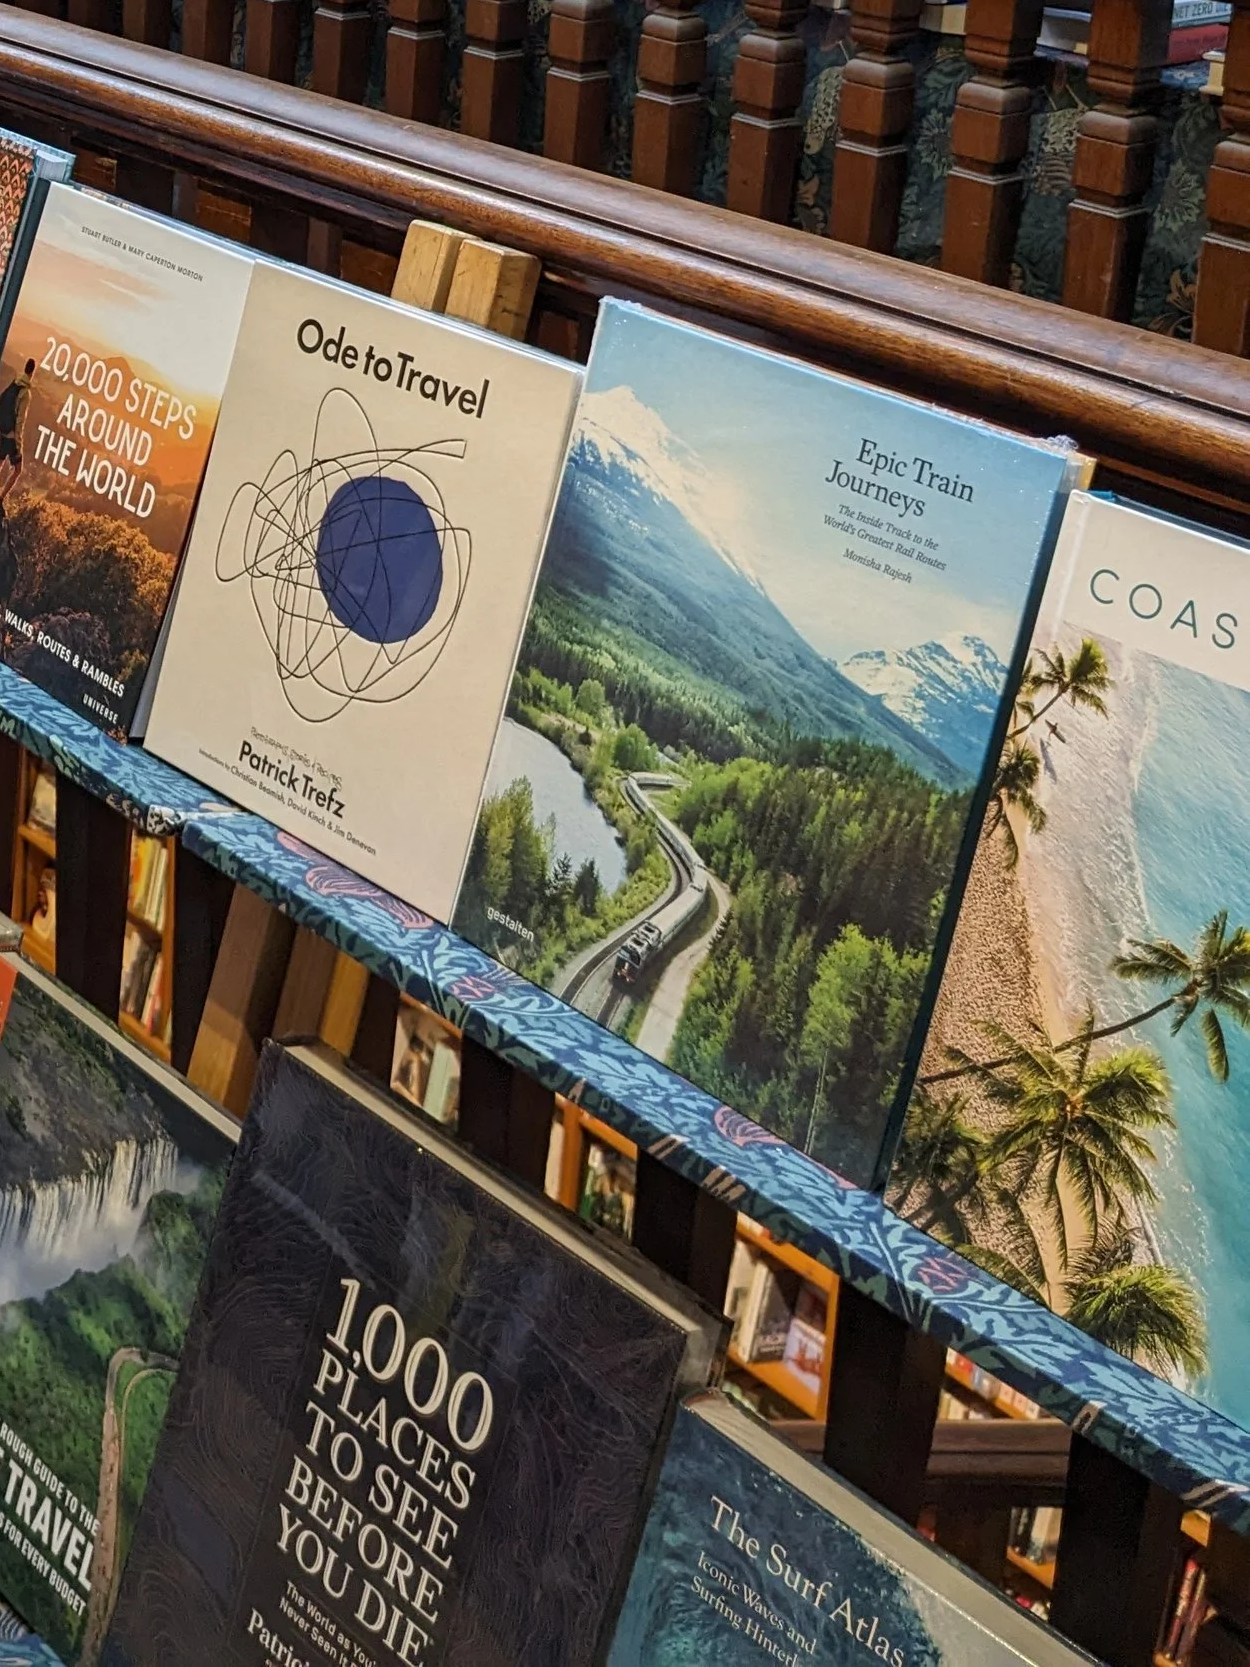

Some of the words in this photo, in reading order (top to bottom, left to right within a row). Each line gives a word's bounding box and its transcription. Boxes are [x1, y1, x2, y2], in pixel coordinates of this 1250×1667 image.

[81, 226, 102, 239] STUART
[102, 232, 122, 248] BUTLER
[122, 242, 127, 251] &
[127, 244, 145, 258] MARY
[145, 253, 176, 270] CAPERTON
[177, 264, 204, 282] MORTON
[40, 336, 123, 403] 20,000
[125, 377, 197, 440] STEPS
[297, 318, 358, 369] Ode
[363, 345, 392, 382] to
[396, 351, 490, 419] Travel
[34, 425, 76, 476] THE
[76, 448, 156, 518] WORLD
[56, 393, 153, 466] AROUND
[856, 438, 907, 477] Epic
[913, 457, 974, 503] Train
[825, 459, 926, 518] Journeys
[839, 504, 855, 518] The
[856, 511, 884, 529] Inside
[885, 521, 912, 540] Track
[913, 533, 923, 544] to
[924, 537, 939, 551] the
[823, 514, 857, 536] World's
[857, 527, 894, 551] Greatest
[895, 542, 914, 559] Rail
[915, 551, 947, 571] Routes
[843, 547, 881, 571] Monisha
[883, 564, 912, 584] Rajesh
[4, 608, 34, 643] WALKS,
[36, 631, 71, 663] ROUTES
[72, 654, 79, 668] &
[81, 660, 125, 698] RAMBLES
[82, 693, 119, 725] UNIVERSE
[231, 765, 258, 787] Christian
[258, 780, 286, 805] Beamish,
[287, 797, 307, 815] David
[307, 811, 326, 828] Kinch
[326, 822, 333, 831] &
[332, 824, 345, 838] Jim
[346, 832, 376, 854] Denevan
[239, 740, 299, 793] Patrick
[302, 774, 346, 819] Trefz
[487, 907, 534, 942] gestalten
[327, 1278, 494, 1452] 1,000
[313, 1349, 476, 1510] PLACES
[0, 1424, 32, 1467] ROUGH
[34, 1455, 63, 1497] GUIDE
[65, 1488, 78, 1514] TO
[79, 1503, 100, 1537] THE
[306, 1401, 363, 1482] TO
[369, 1464, 458, 1569] SEE
[4, 1518, 22, 1548] FOR
[21, 1538, 50, 1578] EVERY
[49, 1568, 86, 1616] BUDGET
[5, 1461, 93, 1592] TRAVEL
[277, 1503, 354, 1600] YOU
[285, 1455, 444, 1624] BEFORE
[287, 1580, 305, 1607] The
[307, 1601, 336, 1637] World
[337, 1633, 351, 1650] as
[691, 1575, 742, 1630] Surfing
[698, 1550, 739, 1595] Iconic
[742, 1583, 784, 1631] Waves
[787, 1625, 817, 1655] and
[711, 1495, 761, 1559] The
[766, 1543, 833, 1610] Surf
[829, 1597, 904, 1667] Atlas
[280, 1596, 310, 1632] Never
[310, 1627, 337, 1659] Seen
[339, 1653, 349, 1666] It
